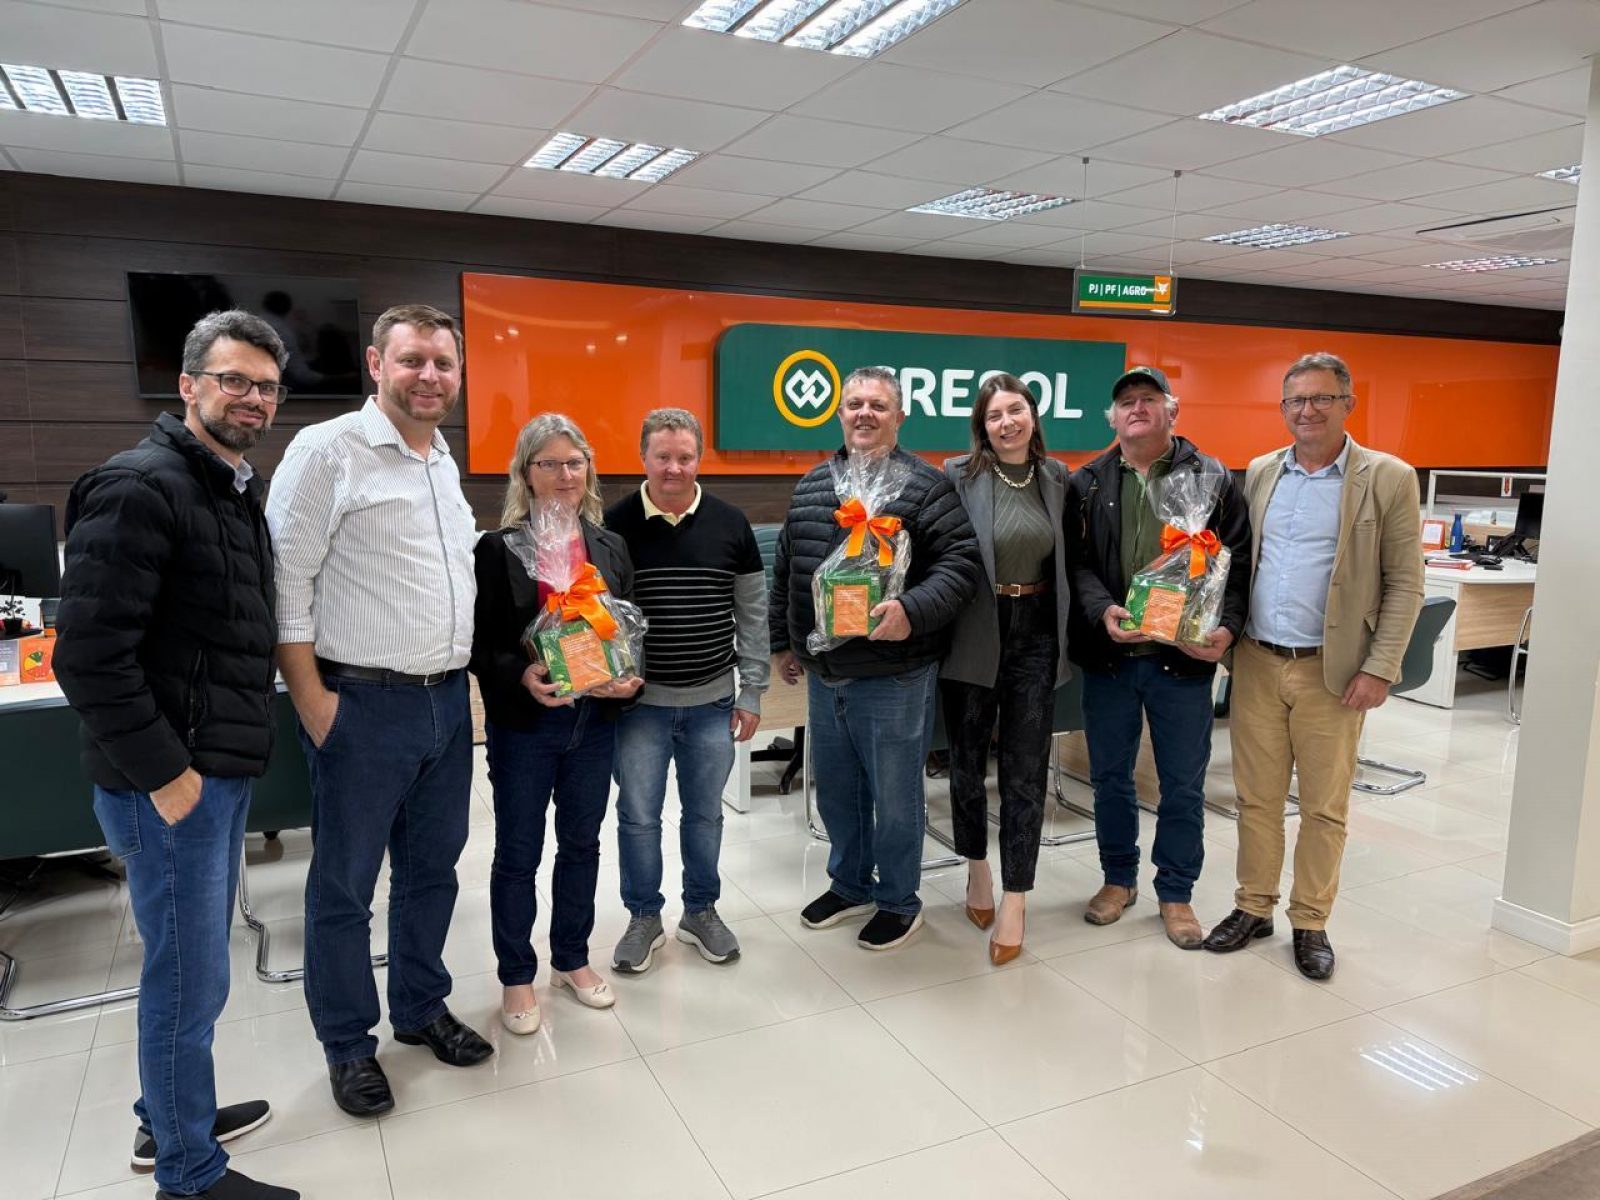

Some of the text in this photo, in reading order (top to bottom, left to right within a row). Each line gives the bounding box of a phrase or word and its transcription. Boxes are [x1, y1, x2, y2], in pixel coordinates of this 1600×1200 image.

[1088, 283, 1099, 294] PJ
[1105, 284, 1117, 295] PF
[1122, 285, 1147, 296] AGRO
[873, 365, 1084, 419] REOL
